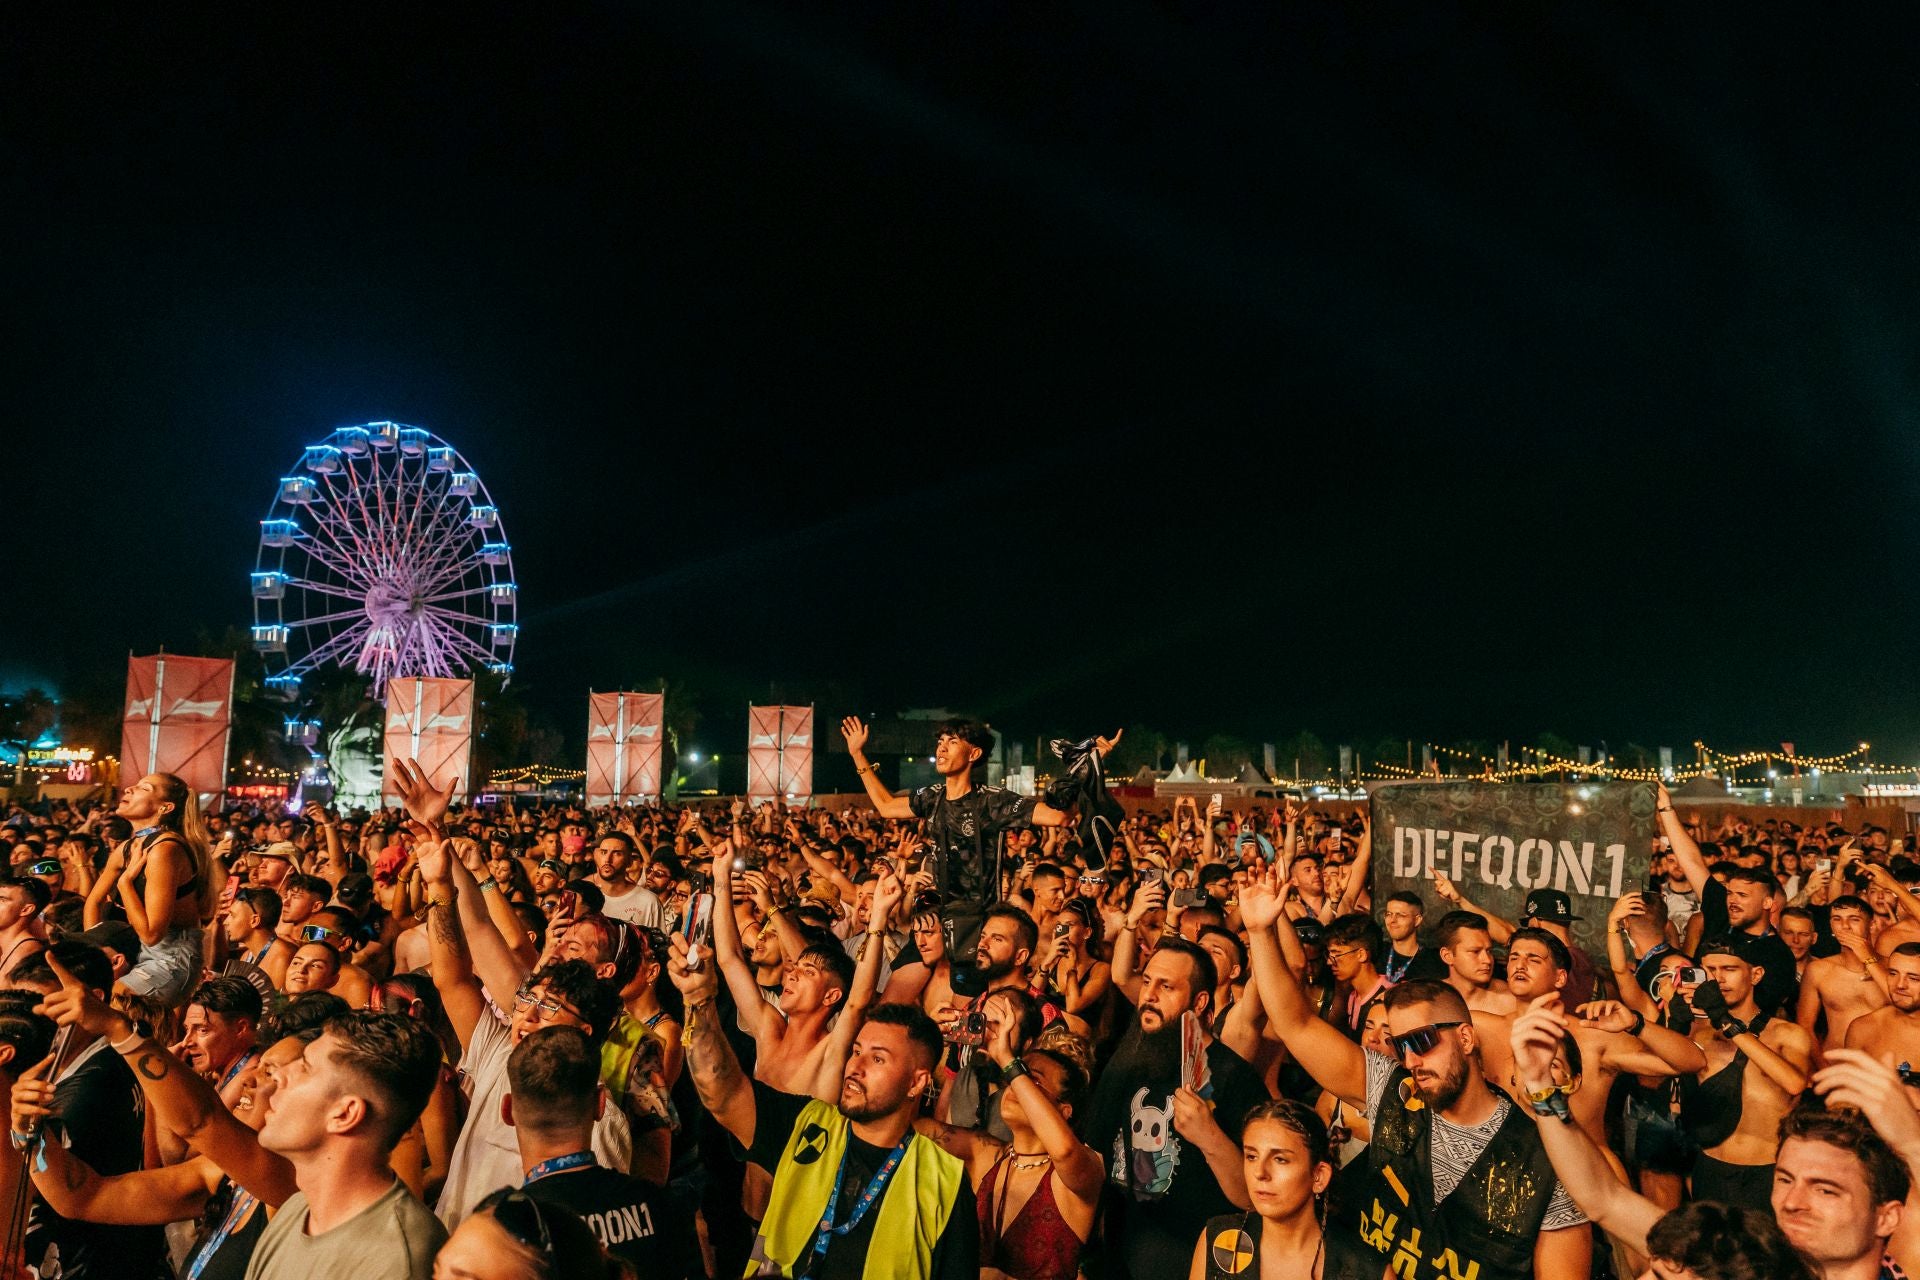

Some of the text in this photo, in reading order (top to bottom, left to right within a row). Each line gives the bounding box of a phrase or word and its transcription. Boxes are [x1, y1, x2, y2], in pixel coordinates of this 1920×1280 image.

[1393, 826, 1626, 898] DEFQON.1
[1555, 899, 1567, 914] LA
[578, 1202, 655, 1248] QON.1
